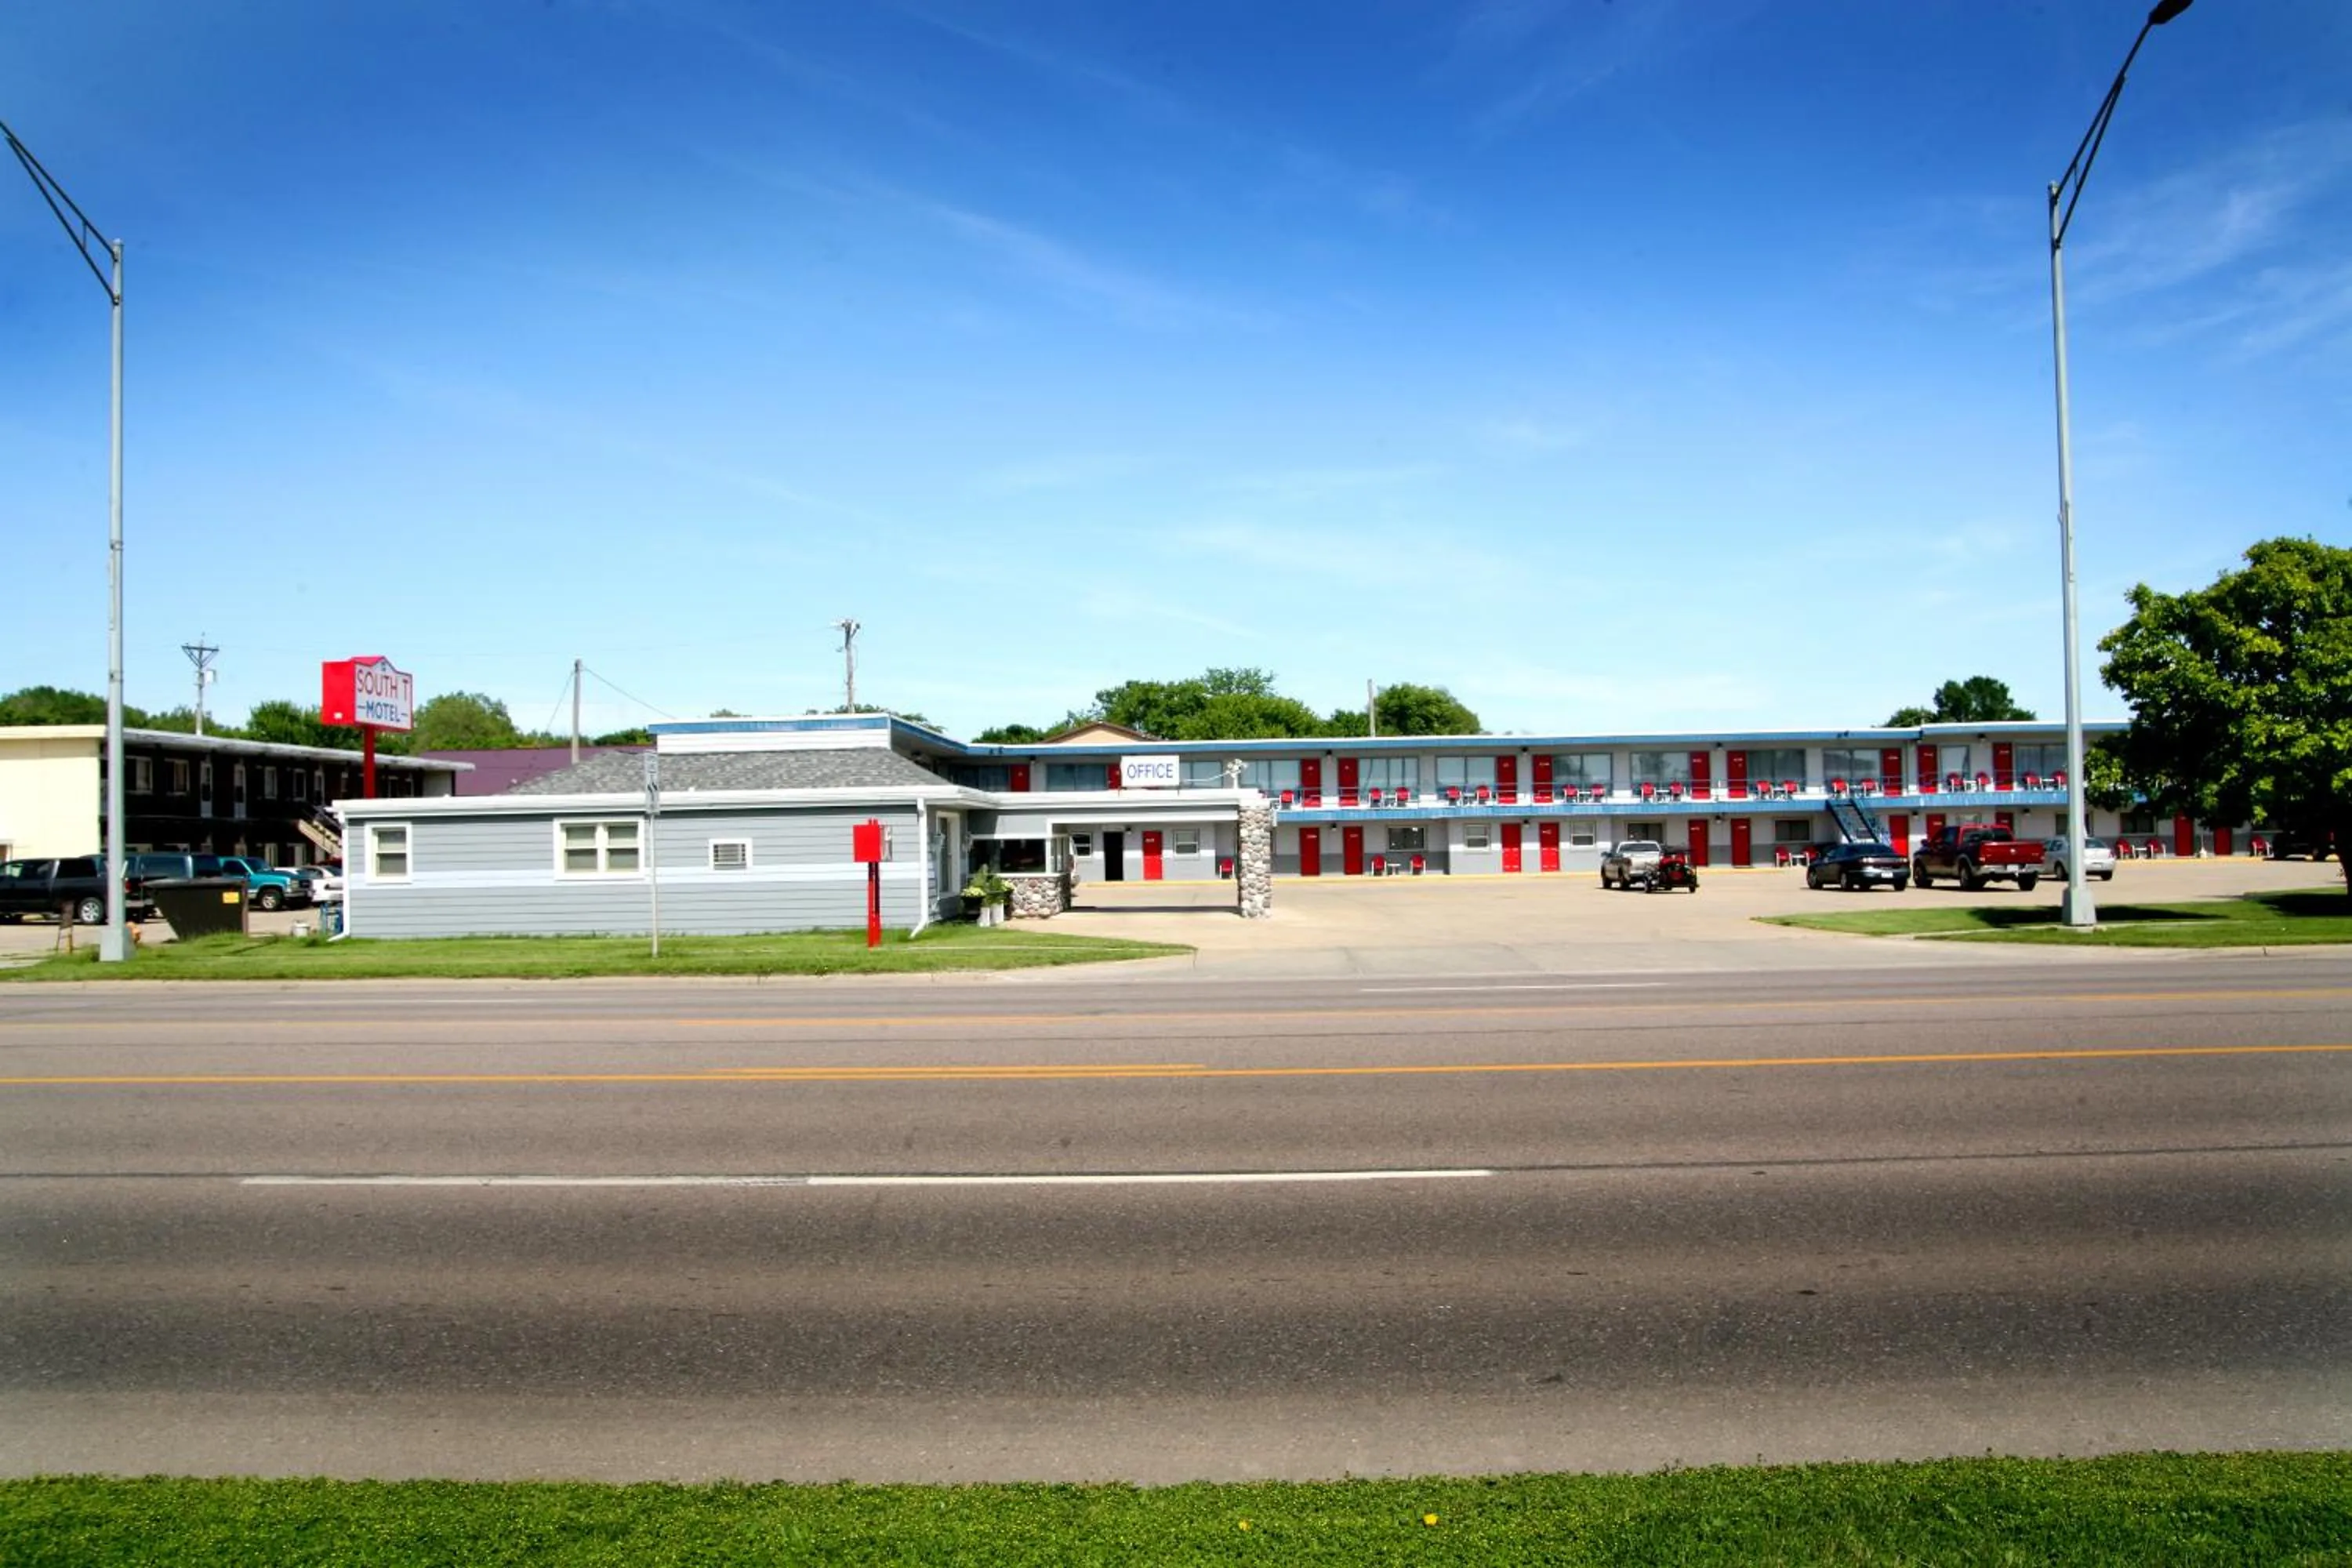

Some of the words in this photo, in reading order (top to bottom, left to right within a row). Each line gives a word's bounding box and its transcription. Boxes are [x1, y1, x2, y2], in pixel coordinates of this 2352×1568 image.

[357, 669, 397, 699] SOUTH
[402, 678, 408, 702] T
[366, 701, 401, 722] MOTEL
[1127, 763, 1174, 779] OFFICE
